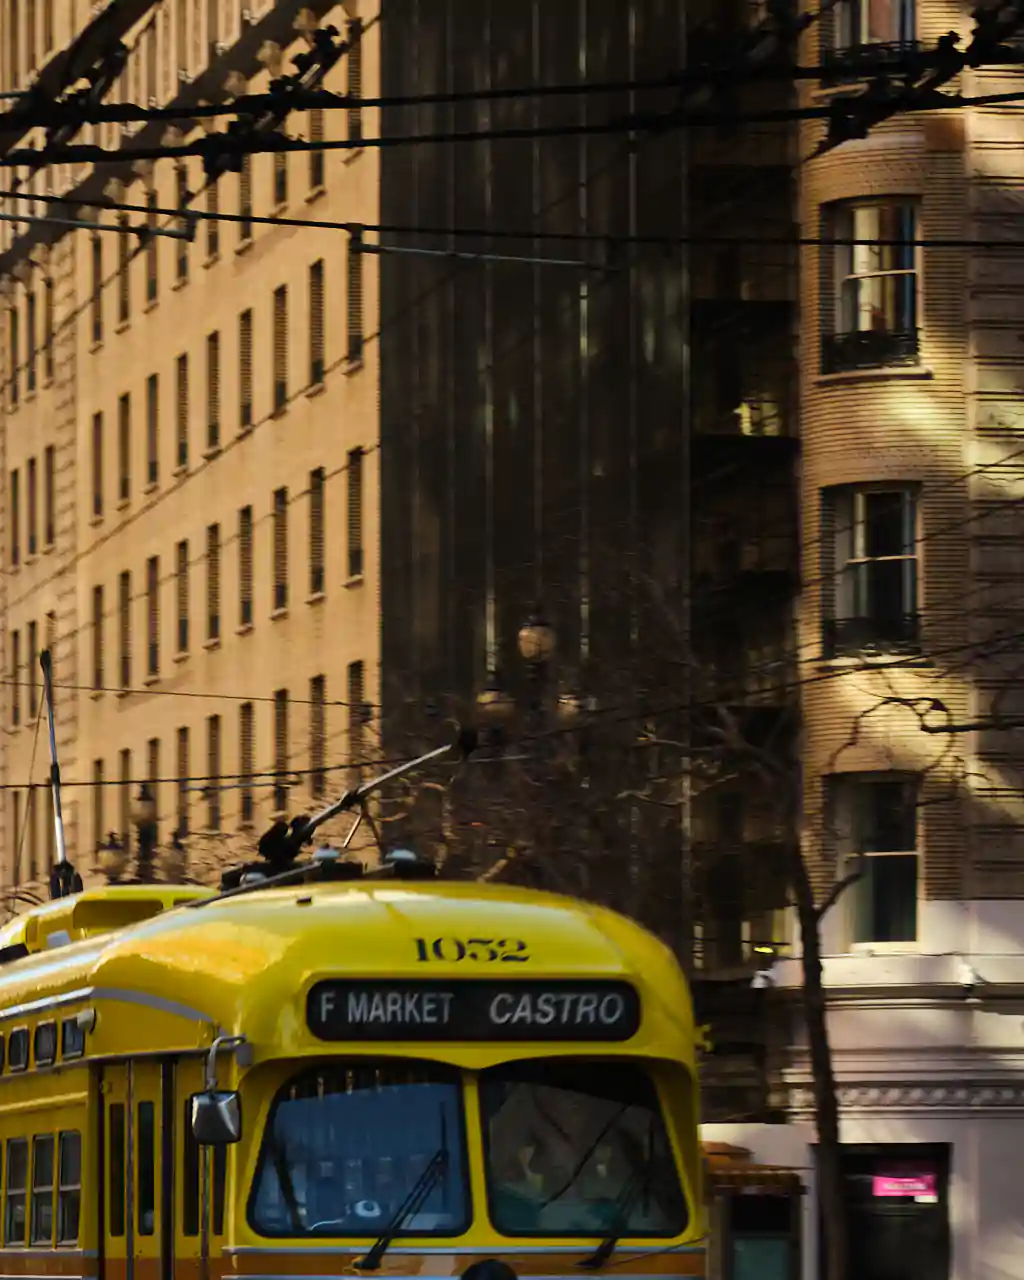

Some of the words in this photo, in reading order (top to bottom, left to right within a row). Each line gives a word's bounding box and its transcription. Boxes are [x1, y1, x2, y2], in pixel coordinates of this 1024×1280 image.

[415, 938, 530, 961] 1052
[320, 992, 335, 1022] F
[348, 992, 455, 1024] MARKET
[489, 992, 624, 1024] CASTRO
